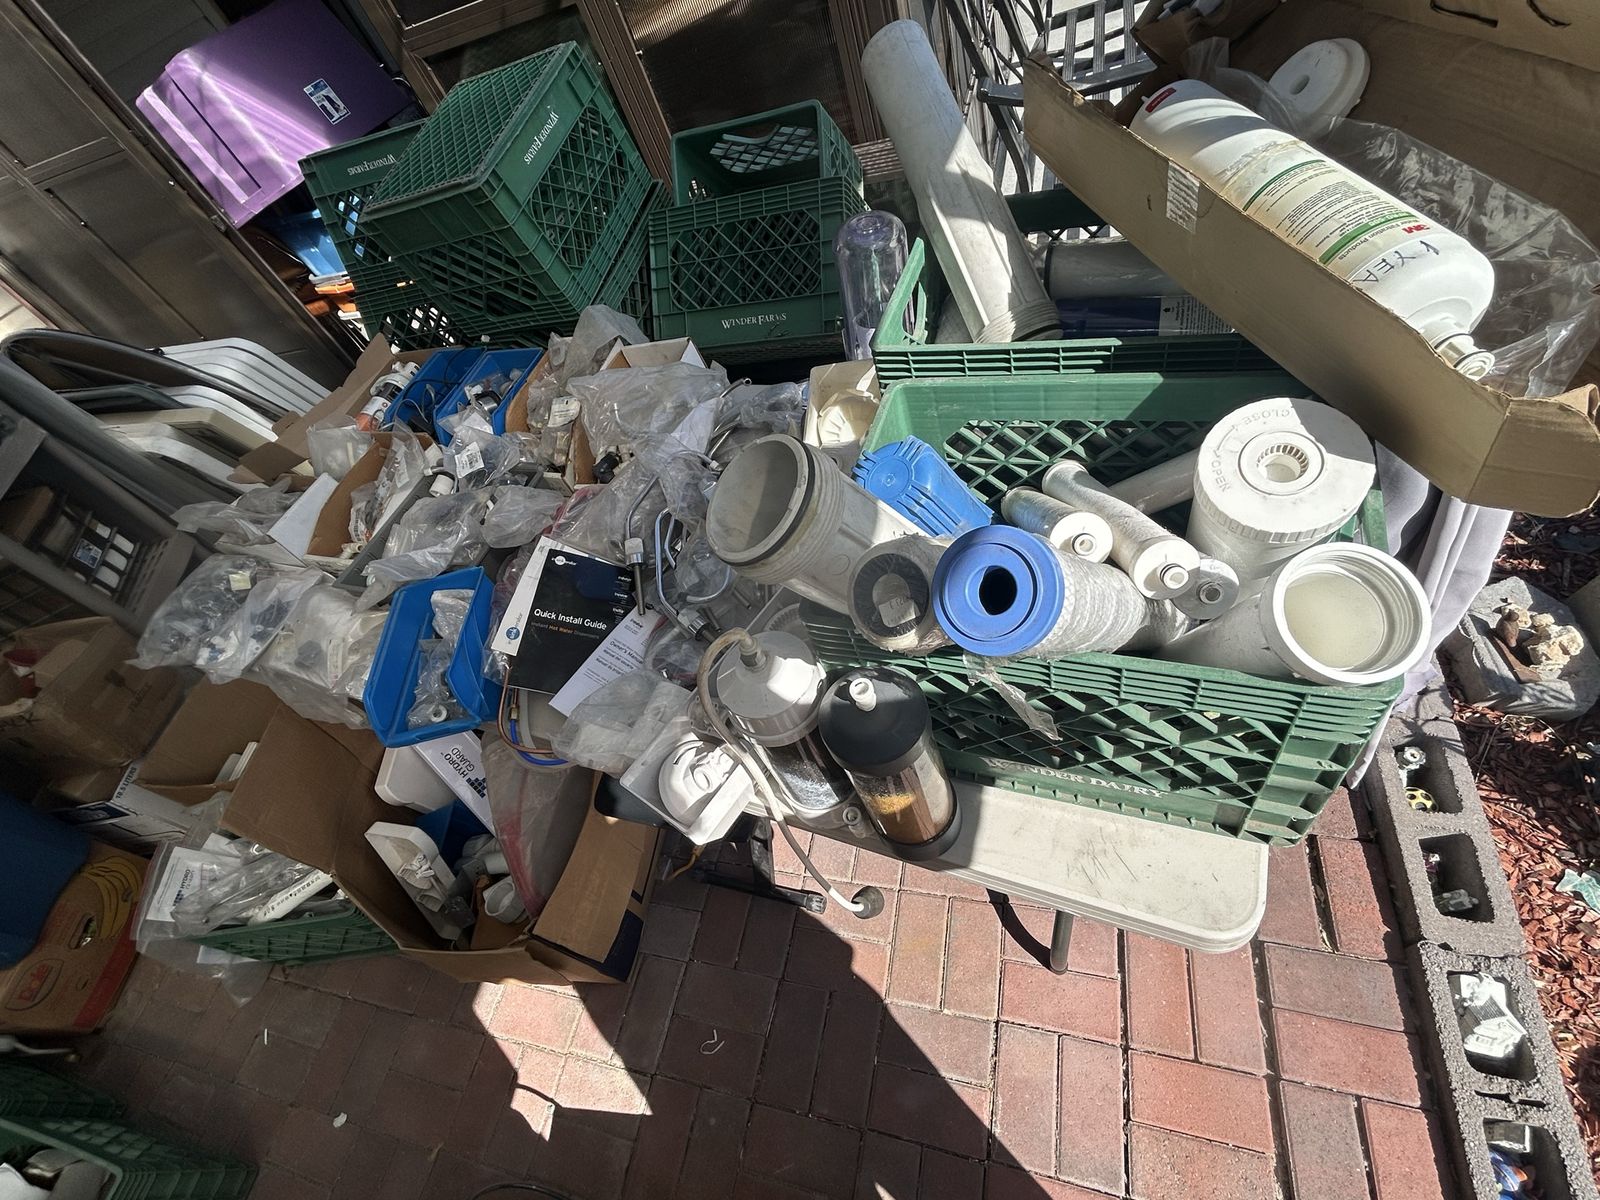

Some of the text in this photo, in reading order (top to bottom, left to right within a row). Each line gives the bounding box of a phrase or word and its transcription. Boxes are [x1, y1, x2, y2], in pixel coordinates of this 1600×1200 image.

[1338, 237, 1370, 260] Products
[721, 316, 757, 329] WINDER
[1241, 408, 1291, 426] CLOSE
[1210, 459, 1231, 492] OPEN
[533, 608, 608, 631] Quick Install Guide
[548, 624, 559, 632] Hot
[609, 640, 627, 654] Owner's
[443, 752, 469, 778] HYDRO
[451, 747, 475, 772] GUARD
[122, 765, 138, 787] LITERS
[983, 757, 1169, 799] WINDER DAIRY
